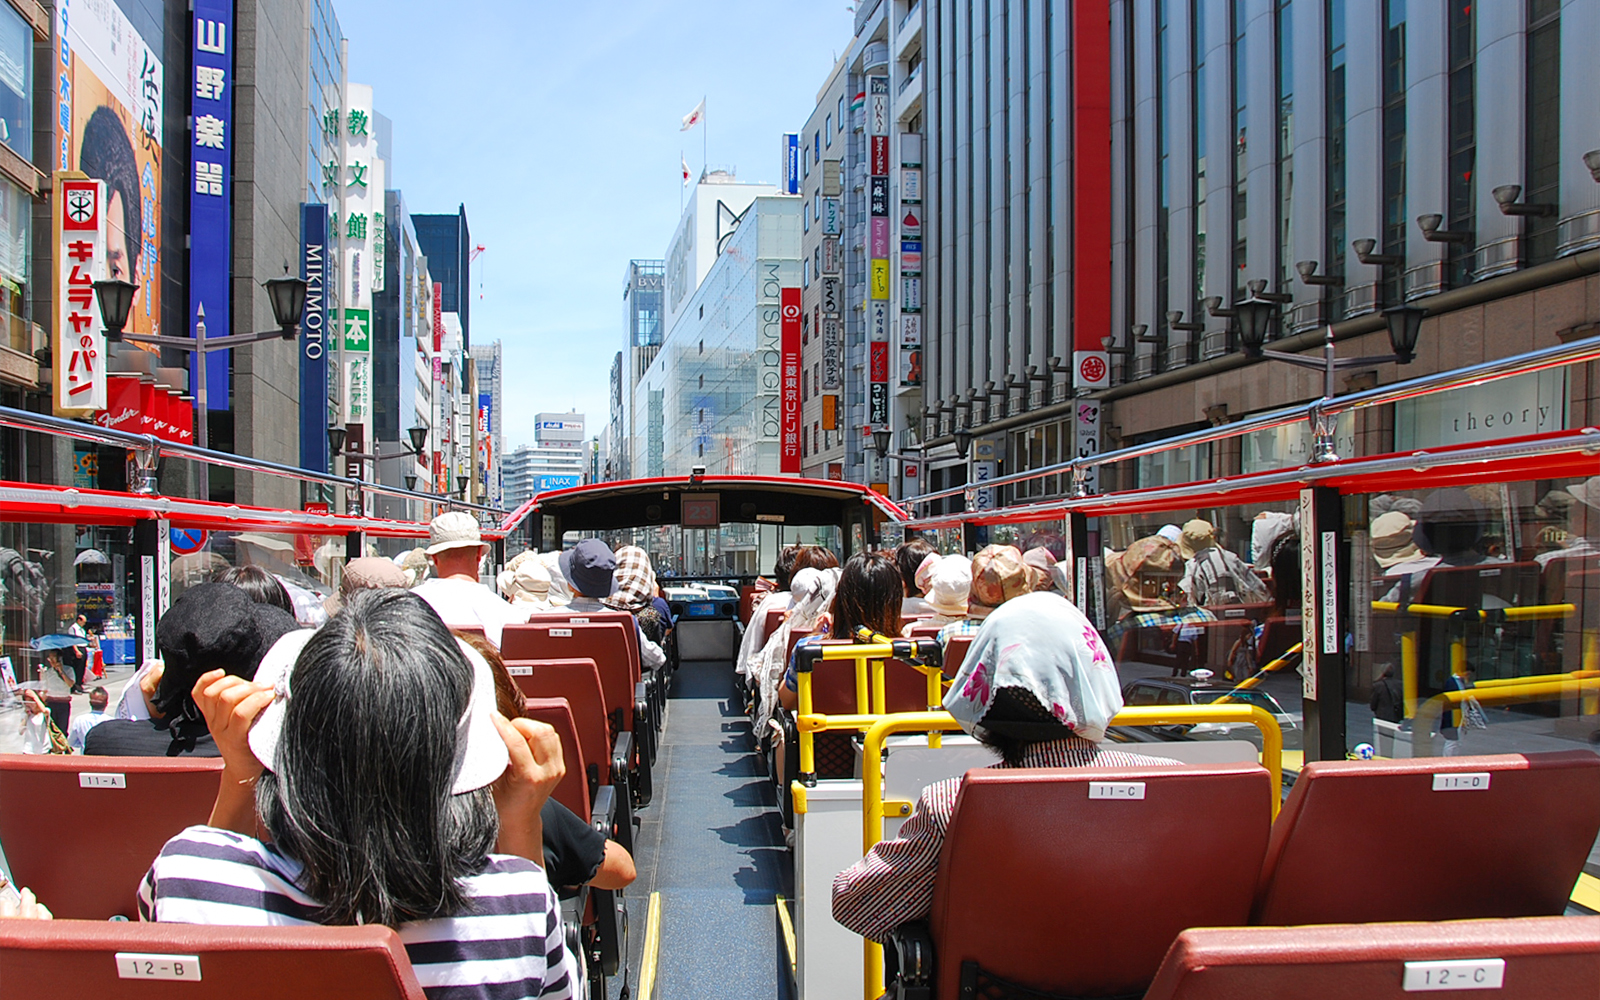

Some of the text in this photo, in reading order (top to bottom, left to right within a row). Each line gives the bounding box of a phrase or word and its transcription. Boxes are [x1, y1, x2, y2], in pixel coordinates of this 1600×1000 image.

[195, 18, 225, 196] 山野楽器
[346, 108, 368, 240] 教文館
[789, 145, 797, 181] Panasonic
[828, 201, 836, 232] トップス
[306, 244, 323, 360] MIKIMOTO
[825, 279, 838, 312] ざくろ
[68, 240, 97, 396] キムラヤのパン
[345, 315, 367, 346] 本
[351, 358, 363, 416] ナルニア国
[98, 407, 139, 428] Fender
[784, 352, 798, 456] 三菱東京UFJ銀行
[1453, 404, 1550, 432] theory
[1289, 435, 1355, 455] thry
[549, 478, 571, 486] INAX
[689, 505, 713, 520] 23
[87, 776, 117, 786] 11-A
[1100, 785, 1135, 797] 11-C
[1444, 776, 1480, 788] 11-D
[132, 961, 185, 976] 12-B
[1424, 968, 1486, 985] 12-C
